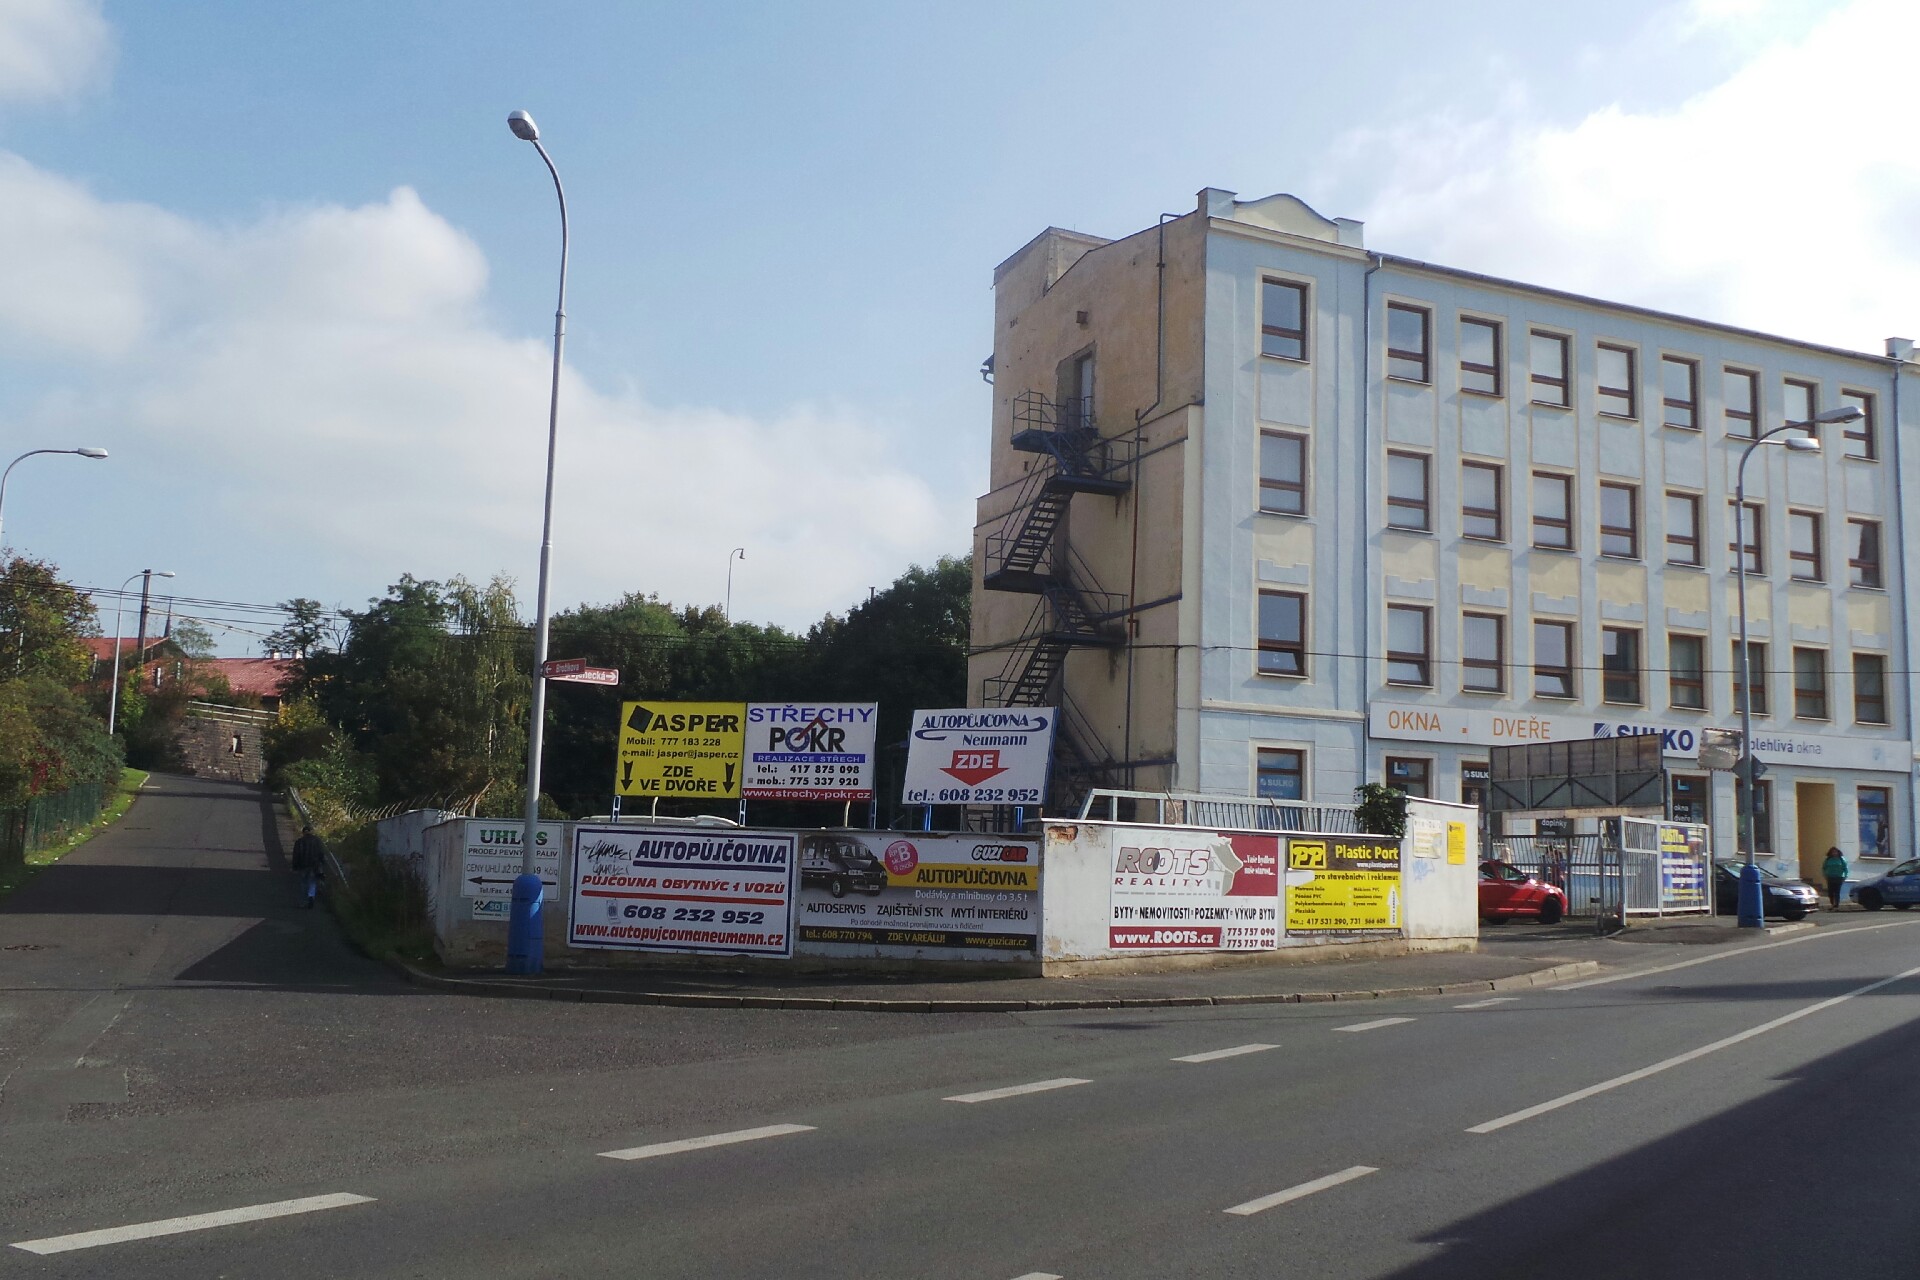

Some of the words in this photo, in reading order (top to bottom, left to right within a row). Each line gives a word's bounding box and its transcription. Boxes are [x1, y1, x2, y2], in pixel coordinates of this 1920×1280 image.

[748, 705, 874, 723] STŘECHY
[921, 713, 1029, 728] AUTOPŮJČOVNA
[1388, 710, 1441, 732] OKNA
[1493, 715, 1551, 740] DVEŘE
[626, 737, 655, 745] Mobil:
[682, 738, 699, 746] 183
[703, 738, 721, 746] 228
[769, 727, 846, 753] POKR
[962, 734, 1028, 746] Neumann
[1796, 740, 1822, 754] okna
[622, 749, 654, 757] e-mail:
[657, 749, 739, 759] jasper@jasper.cz
[758, 755, 815, 763] REALIZACE
[955, 754, 994, 769] ZDE
[662, 765, 694, 777] ZDE
[757, 764, 778, 774] tel.:
[790, 765, 810, 774] 417
[814, 765, 834, 774] 875
[839, 765, 860, 774] 098
[640, 779, 660, 790] VE
[665, 778, 717, 792] DVOŘE
[757, 776, 785, 785] mob.:
[789, 777, 809, 785] 775
[814, 777, 834, 786] 337
[839, 777, 859, 786] 920
[743, 789, 871, 800] www.strechy-pokr.cz
[908, 789, 935, 801] tel.:
[938, 788, 970, 801] 608
[974, 789, 1004, 801] 232
[1007, 788, 1039, 801] 952
[479, 829, 548, 846] UHLS
[635, 838, 787, 864] AUTOPŮJČOVNA
[1335, 844, 1371, 859] Plastic
[1374, 846, 1399, 860] Port
[1115, 847, 1211, 875] ROOTS
[916, 867, 1028, 885] AUTOPŮJČOVNA
[1114, 877, 1204, 887] REALITY
[915, 889, 950, 901] Dodávky
[958, 890, 995, 903] minibusy
[996, 893, 1008, 901] do
[623, 905, 667, 920] 608
[673, 908, 716, 922] 232
[721, 910, 765, 924] 952
[806, 903, 866, 914] AUTOSERVIS
[877, 903, 923, 917] ZAJIŠTĚNÍ
[924, 907, 944, 917] STK
[951, 905, 976, 918] MYTÍ
[977, 907, 1028, 920] INTERIÉRŮ
[1114, 906, 1134, 919] BYTY
[1139, 907, 1190, 920] NEMOVITOSTI
[1195, 907, 1230, 920] POZEMKY
[1234, 905, 1257, 920] VÝKUP
[576, 924, 784, 946] www.autopujcovnaneumann.cz
[822, 930, 837, 939] 608
[839, 931, 855, 940] 770
[857, 932, 873, 940] 794
[887, 932, 904, 941] ZDE
[905, 933, 911, 941] V
[1114, 931, 1214, 944] www.ROOTS.cz
[1227, 928, 1242, 936] 775
[1244, 928, 1258, 936] 757
[1260, 928, 1276, 936] 090
[965, 936, 1027, 947] www.guzicar.cz
[1227, 939, 1242, 948] 775
[1244, 939, 1258, 948] 757
